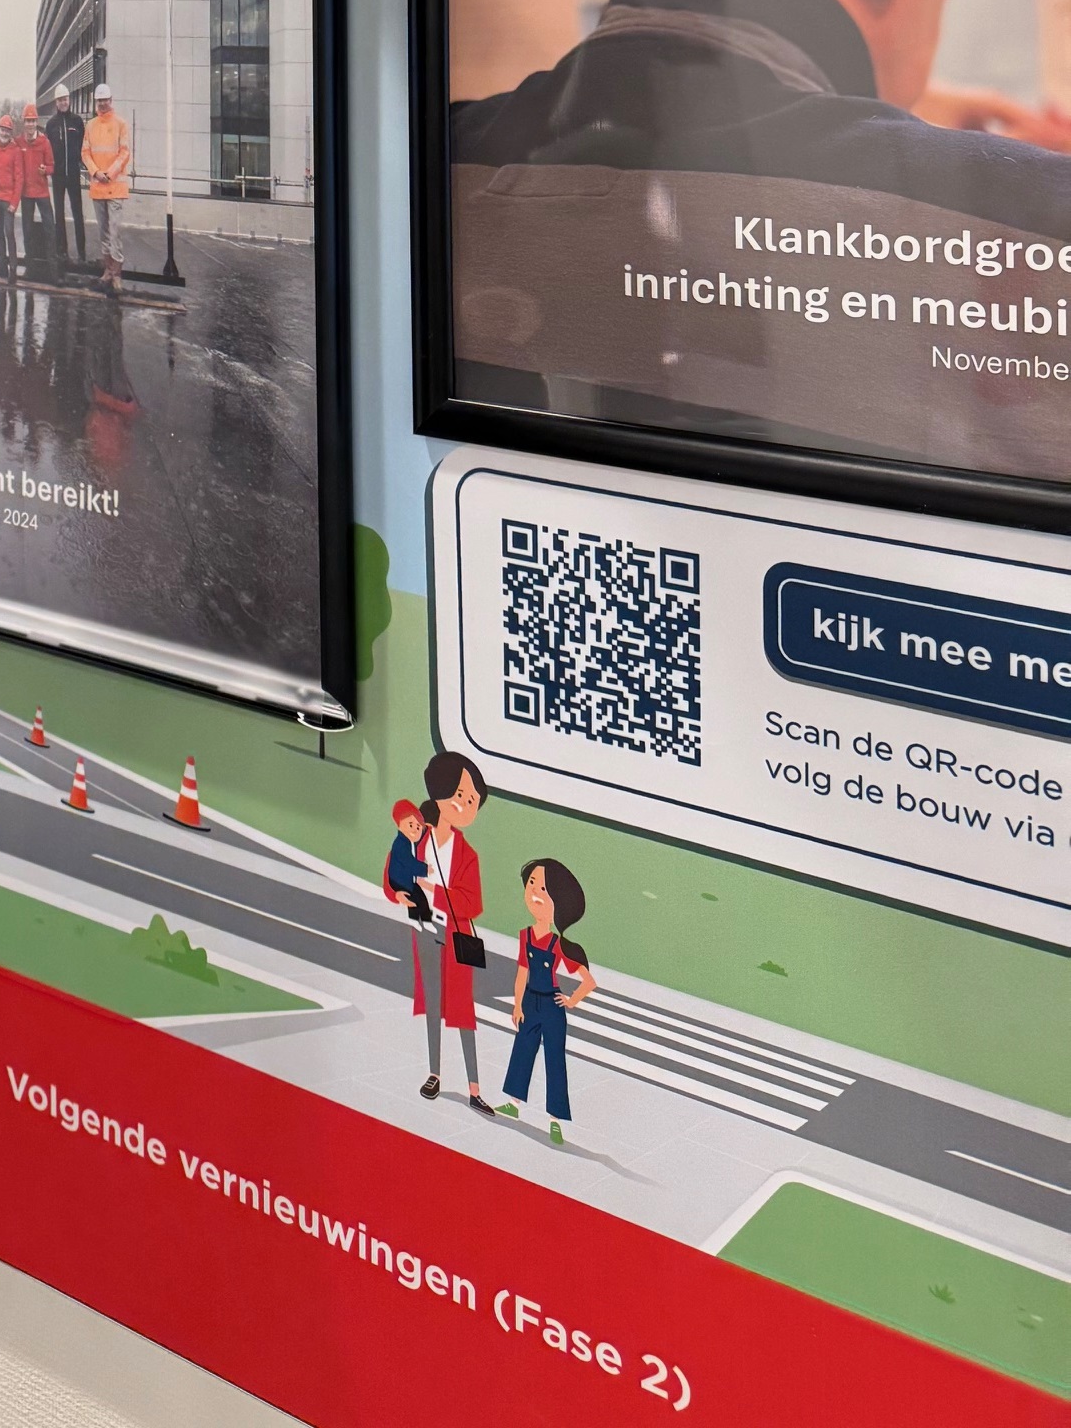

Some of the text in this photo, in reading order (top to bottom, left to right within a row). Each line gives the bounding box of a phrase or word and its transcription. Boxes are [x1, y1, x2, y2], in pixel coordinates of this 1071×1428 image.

[734, 216, 1071, 277] Klankbordgroe
[623, 263, 1068, 336] inrichting en meubi
[931, 345, 1070, 381] Novembe
[3, 508, 38, 530] 2024
[21, 471, 120, 517] bereikt!
[813, 607, 1071, 688] kijk mee me
[765, 711, 1063, 801] Scan de QR-code
[765, 759, 1055, 847] volg de bouw via
[6, 1066, 692, 1412] Volgende vernieuwingen (Fase 2)
